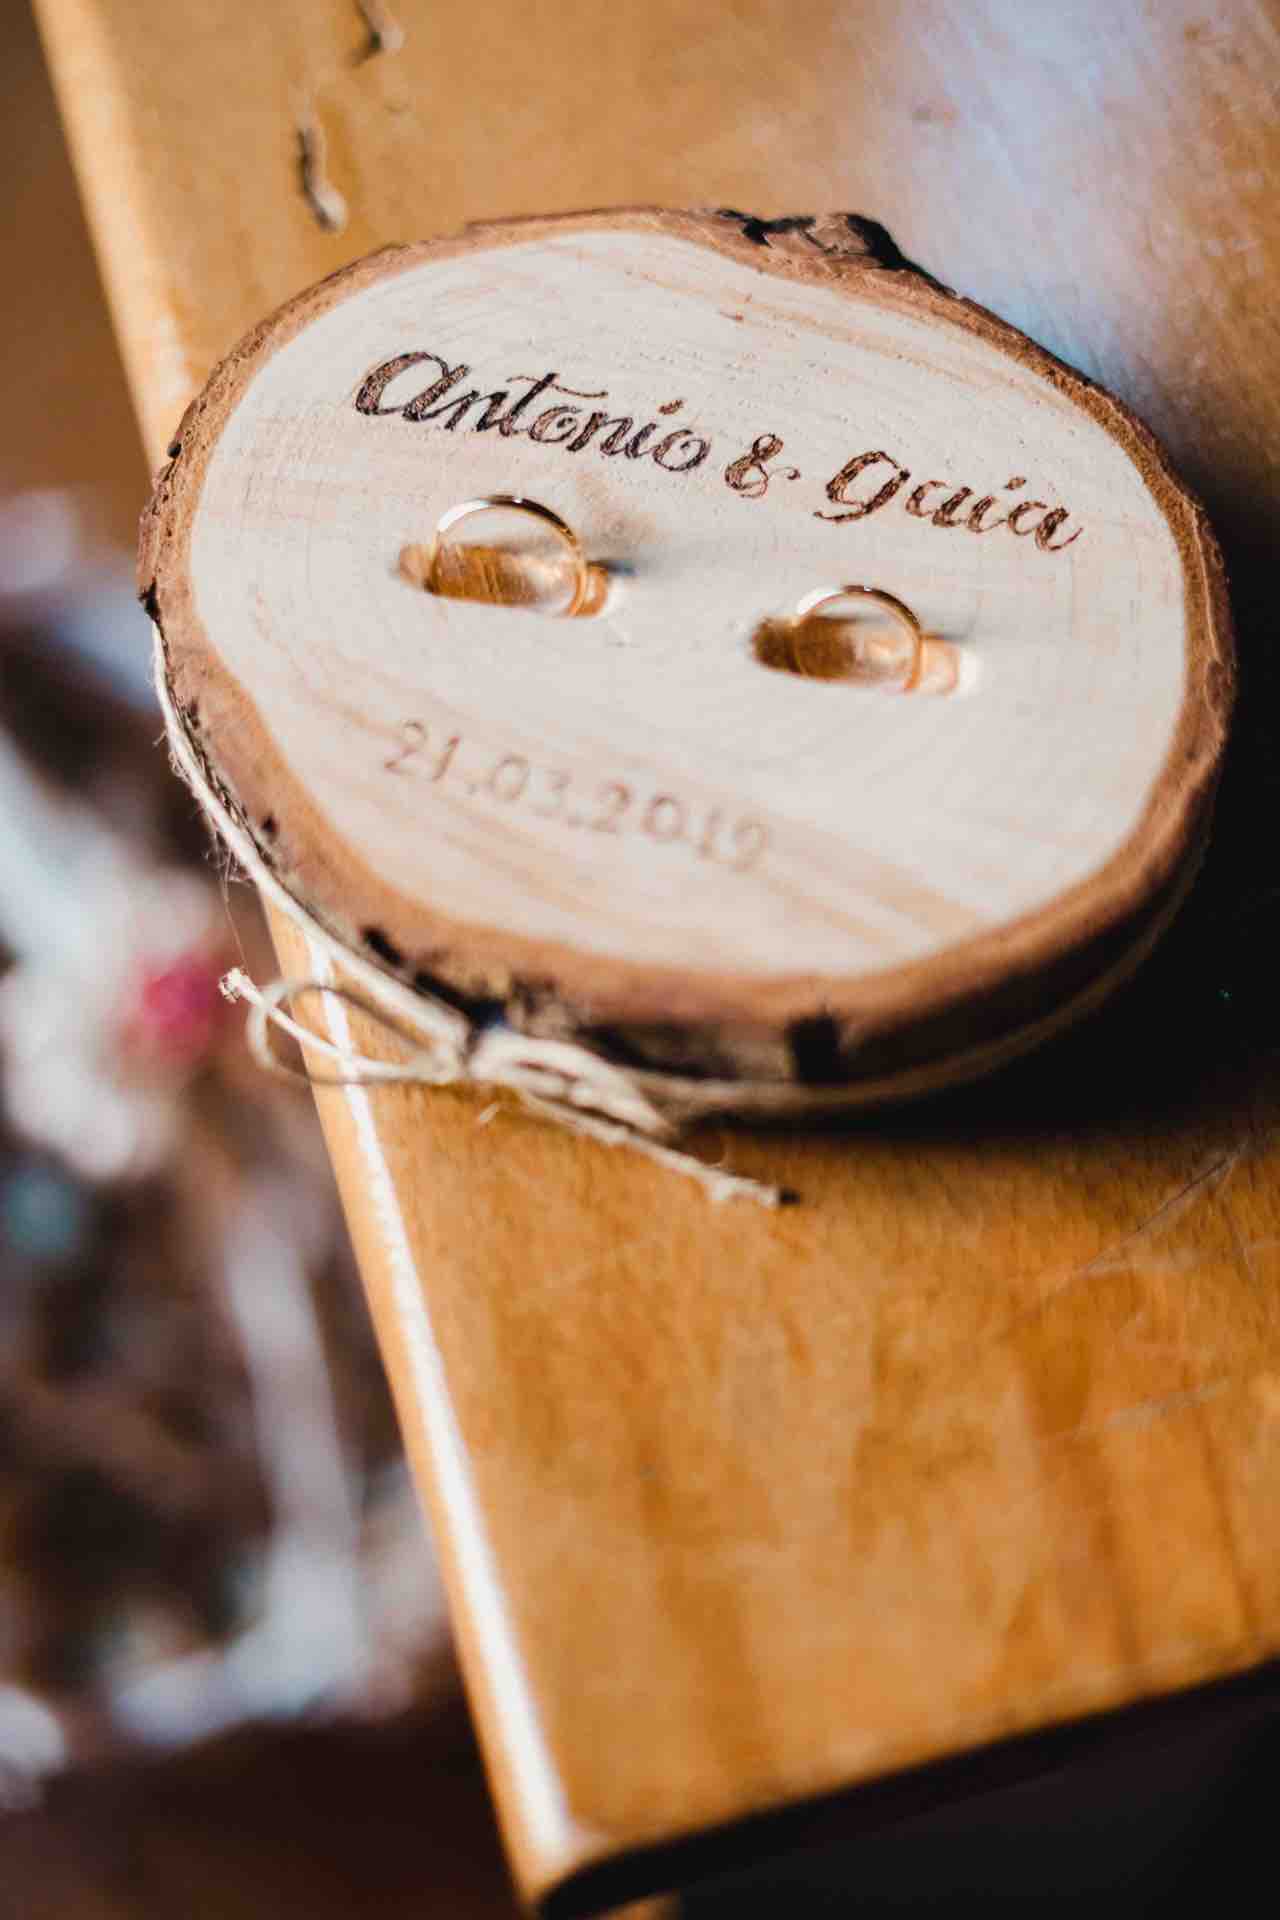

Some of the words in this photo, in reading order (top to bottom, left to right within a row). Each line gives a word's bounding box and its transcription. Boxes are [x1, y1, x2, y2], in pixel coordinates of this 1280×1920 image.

[354, 350, 712, 472] Antonio
[724, 433, 801, 499] &
[383, 718, 772, 873] 21.03.2019
